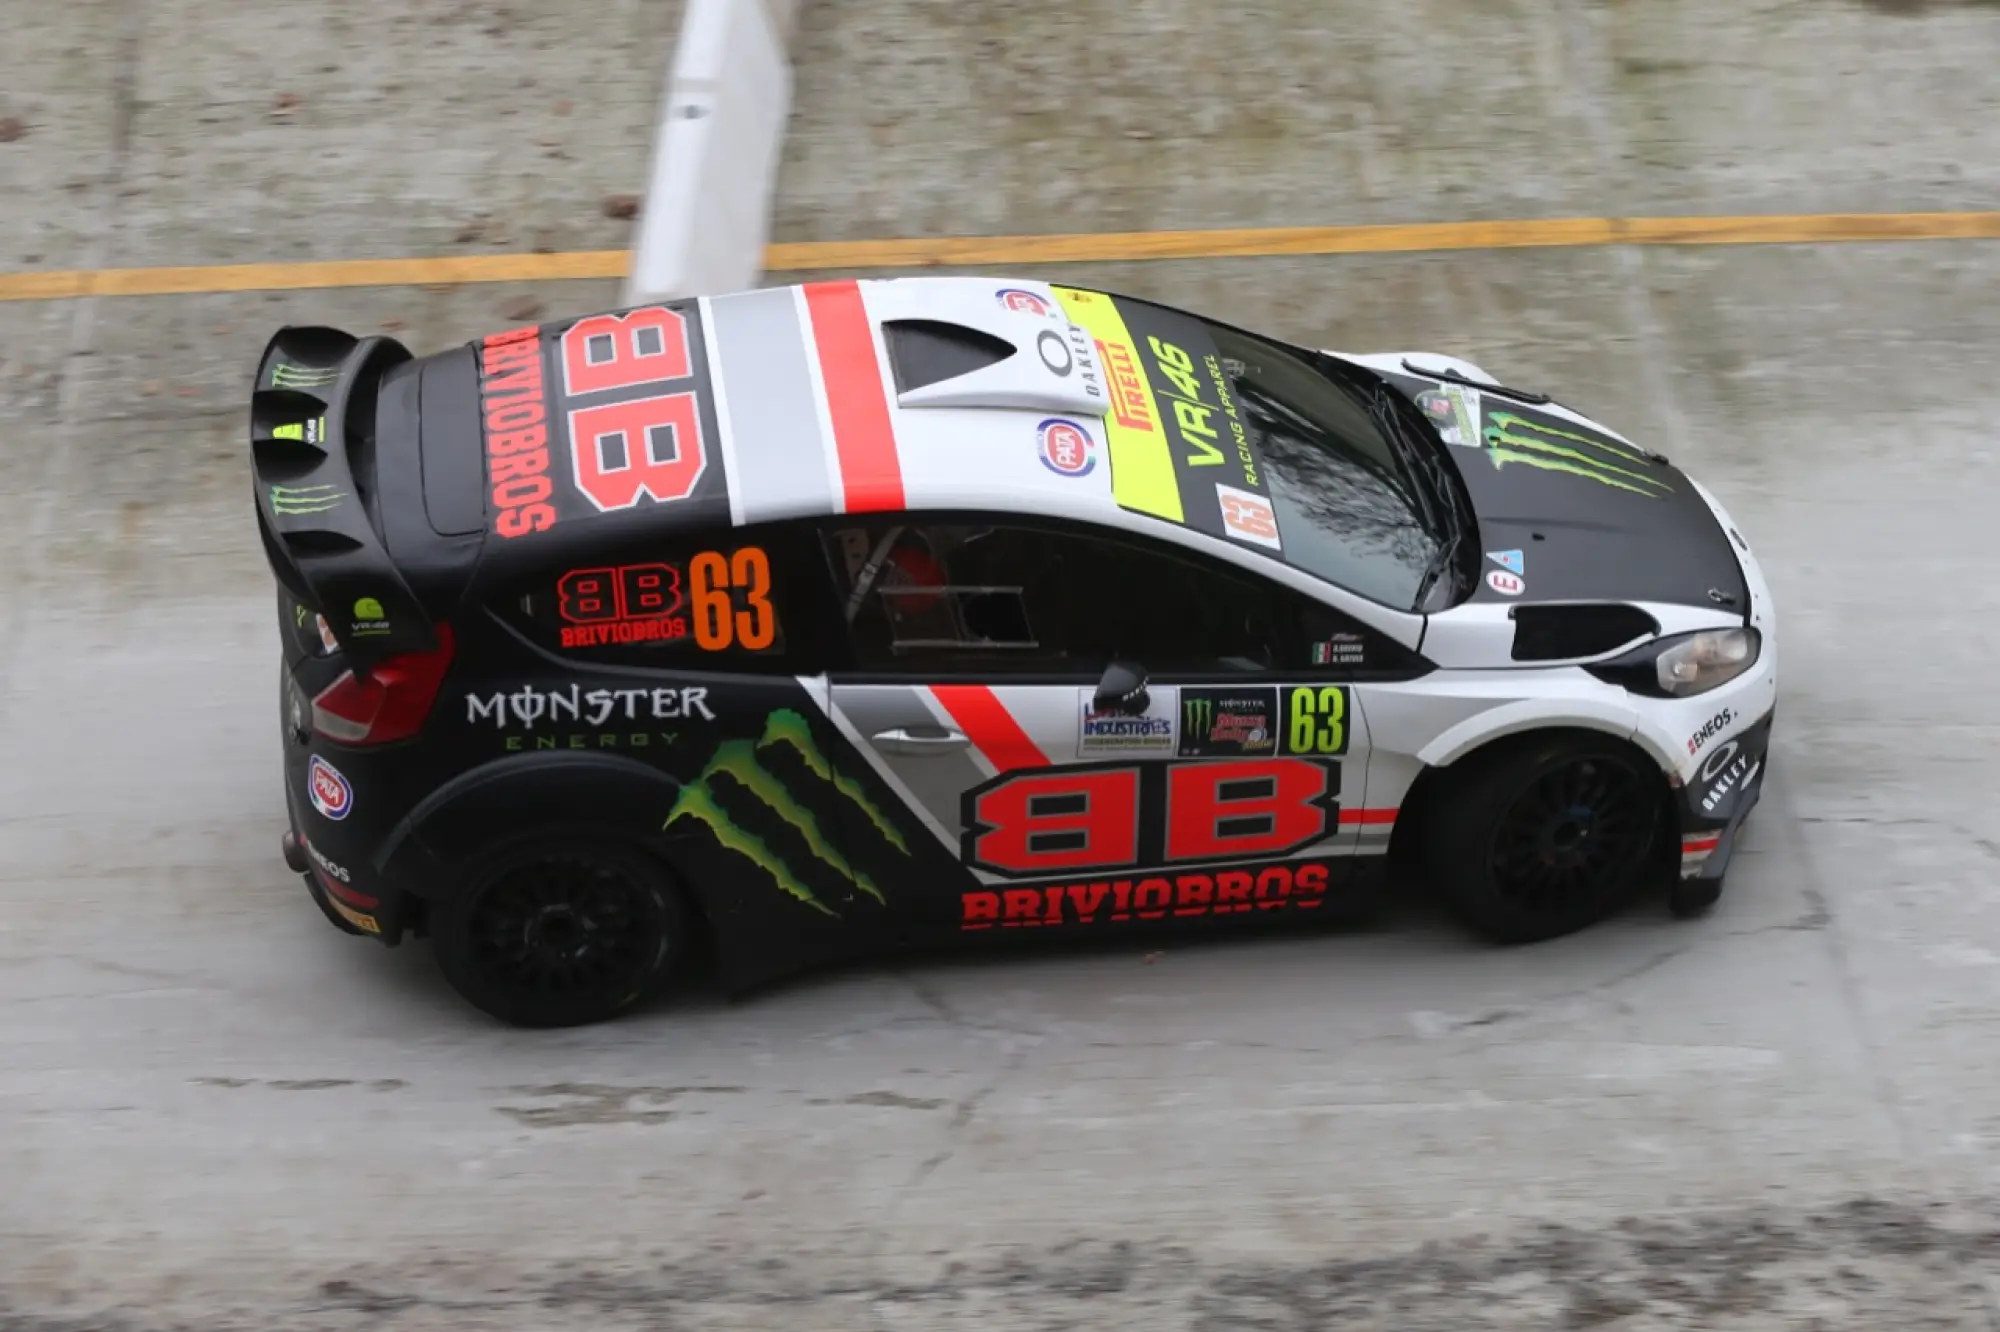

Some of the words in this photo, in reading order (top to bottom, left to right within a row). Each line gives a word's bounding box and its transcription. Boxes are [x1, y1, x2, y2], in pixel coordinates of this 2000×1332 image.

[1093, 339, 1154, 432] PIRELLI
[1203, 354, 1240, 420] APPAREL
[483, 325, 557, 539] BRIVIOBROS
[1230, 421, 1260, 487] RACING
[1210, 493, 1278, 539] 63
[690, 547, 775, 651] 63
[561, 617, 687, 648] BRIVIOBROS
[464, 683, 717, 730] MONSTER
[1290, 687, 1345, 754] 63
[1693, 708, 1732, 748] ENEOS
[505, 732, 679, 751] ENERGY
[315, 769, 340, 805] PATA
[1701, 754, 1748, 813] OAKLEY
[961, 863, 1330, 932] BRIVIOBROS
